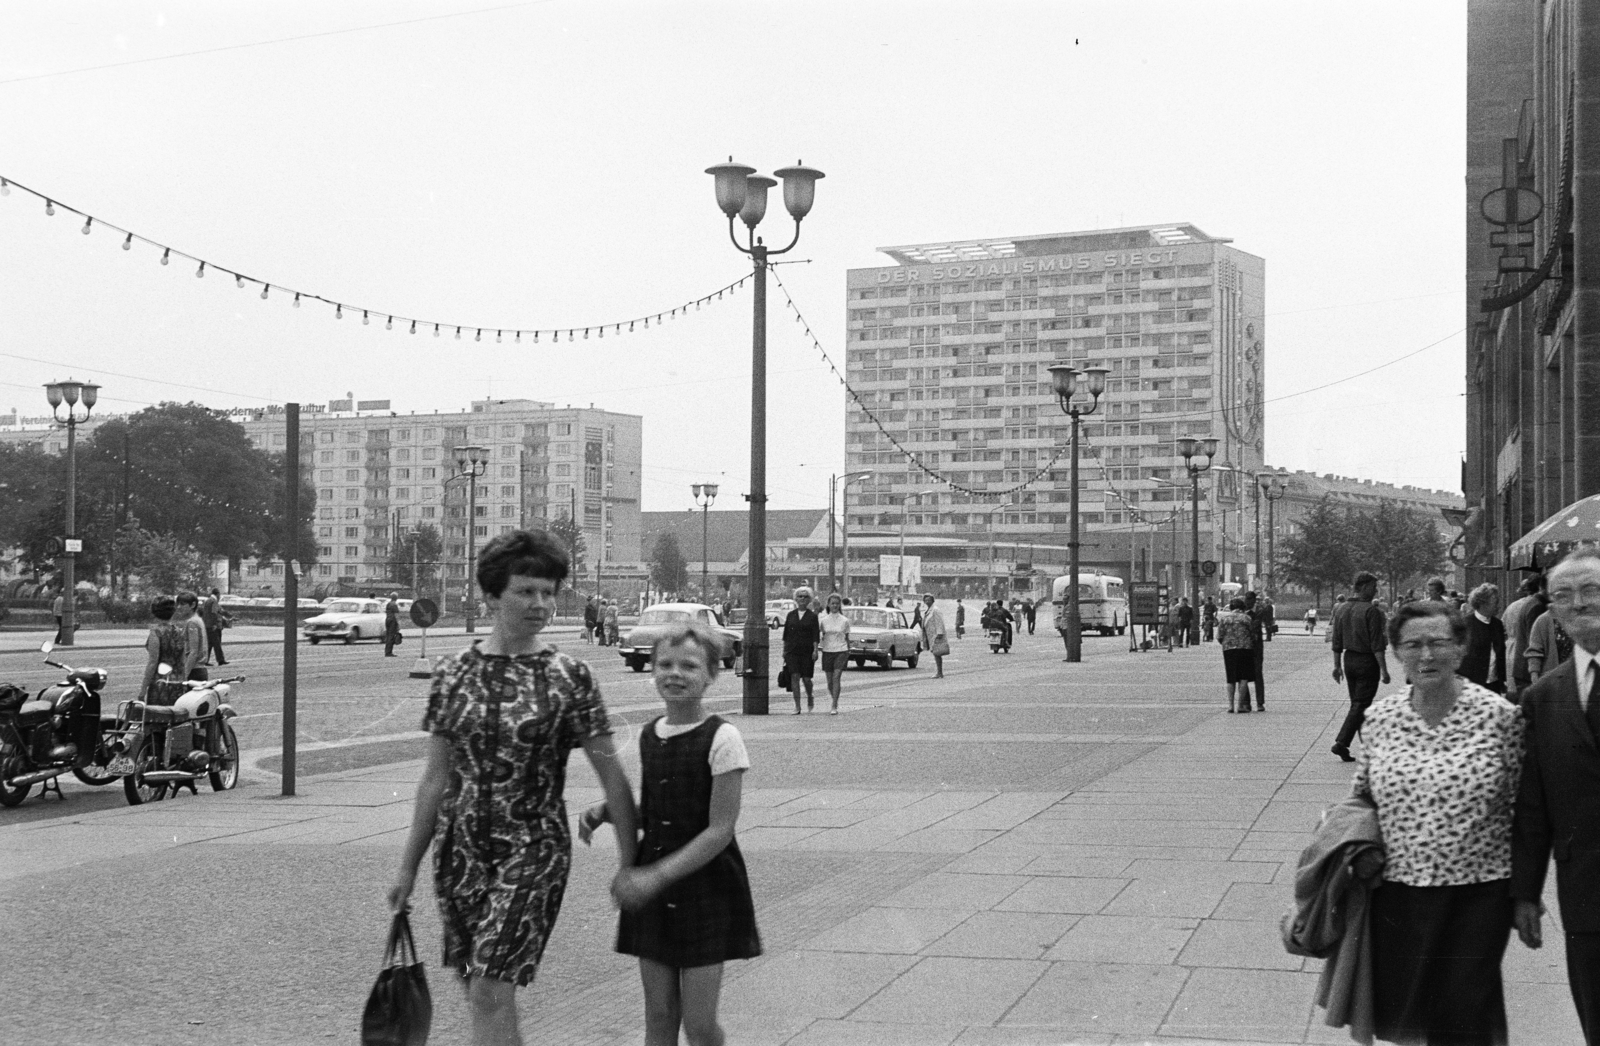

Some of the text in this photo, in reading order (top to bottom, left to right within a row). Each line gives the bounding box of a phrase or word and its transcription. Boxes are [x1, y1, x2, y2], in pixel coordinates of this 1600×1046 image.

[877, 250, 1178, 284] DER SOZIALISMUS SIEGT
